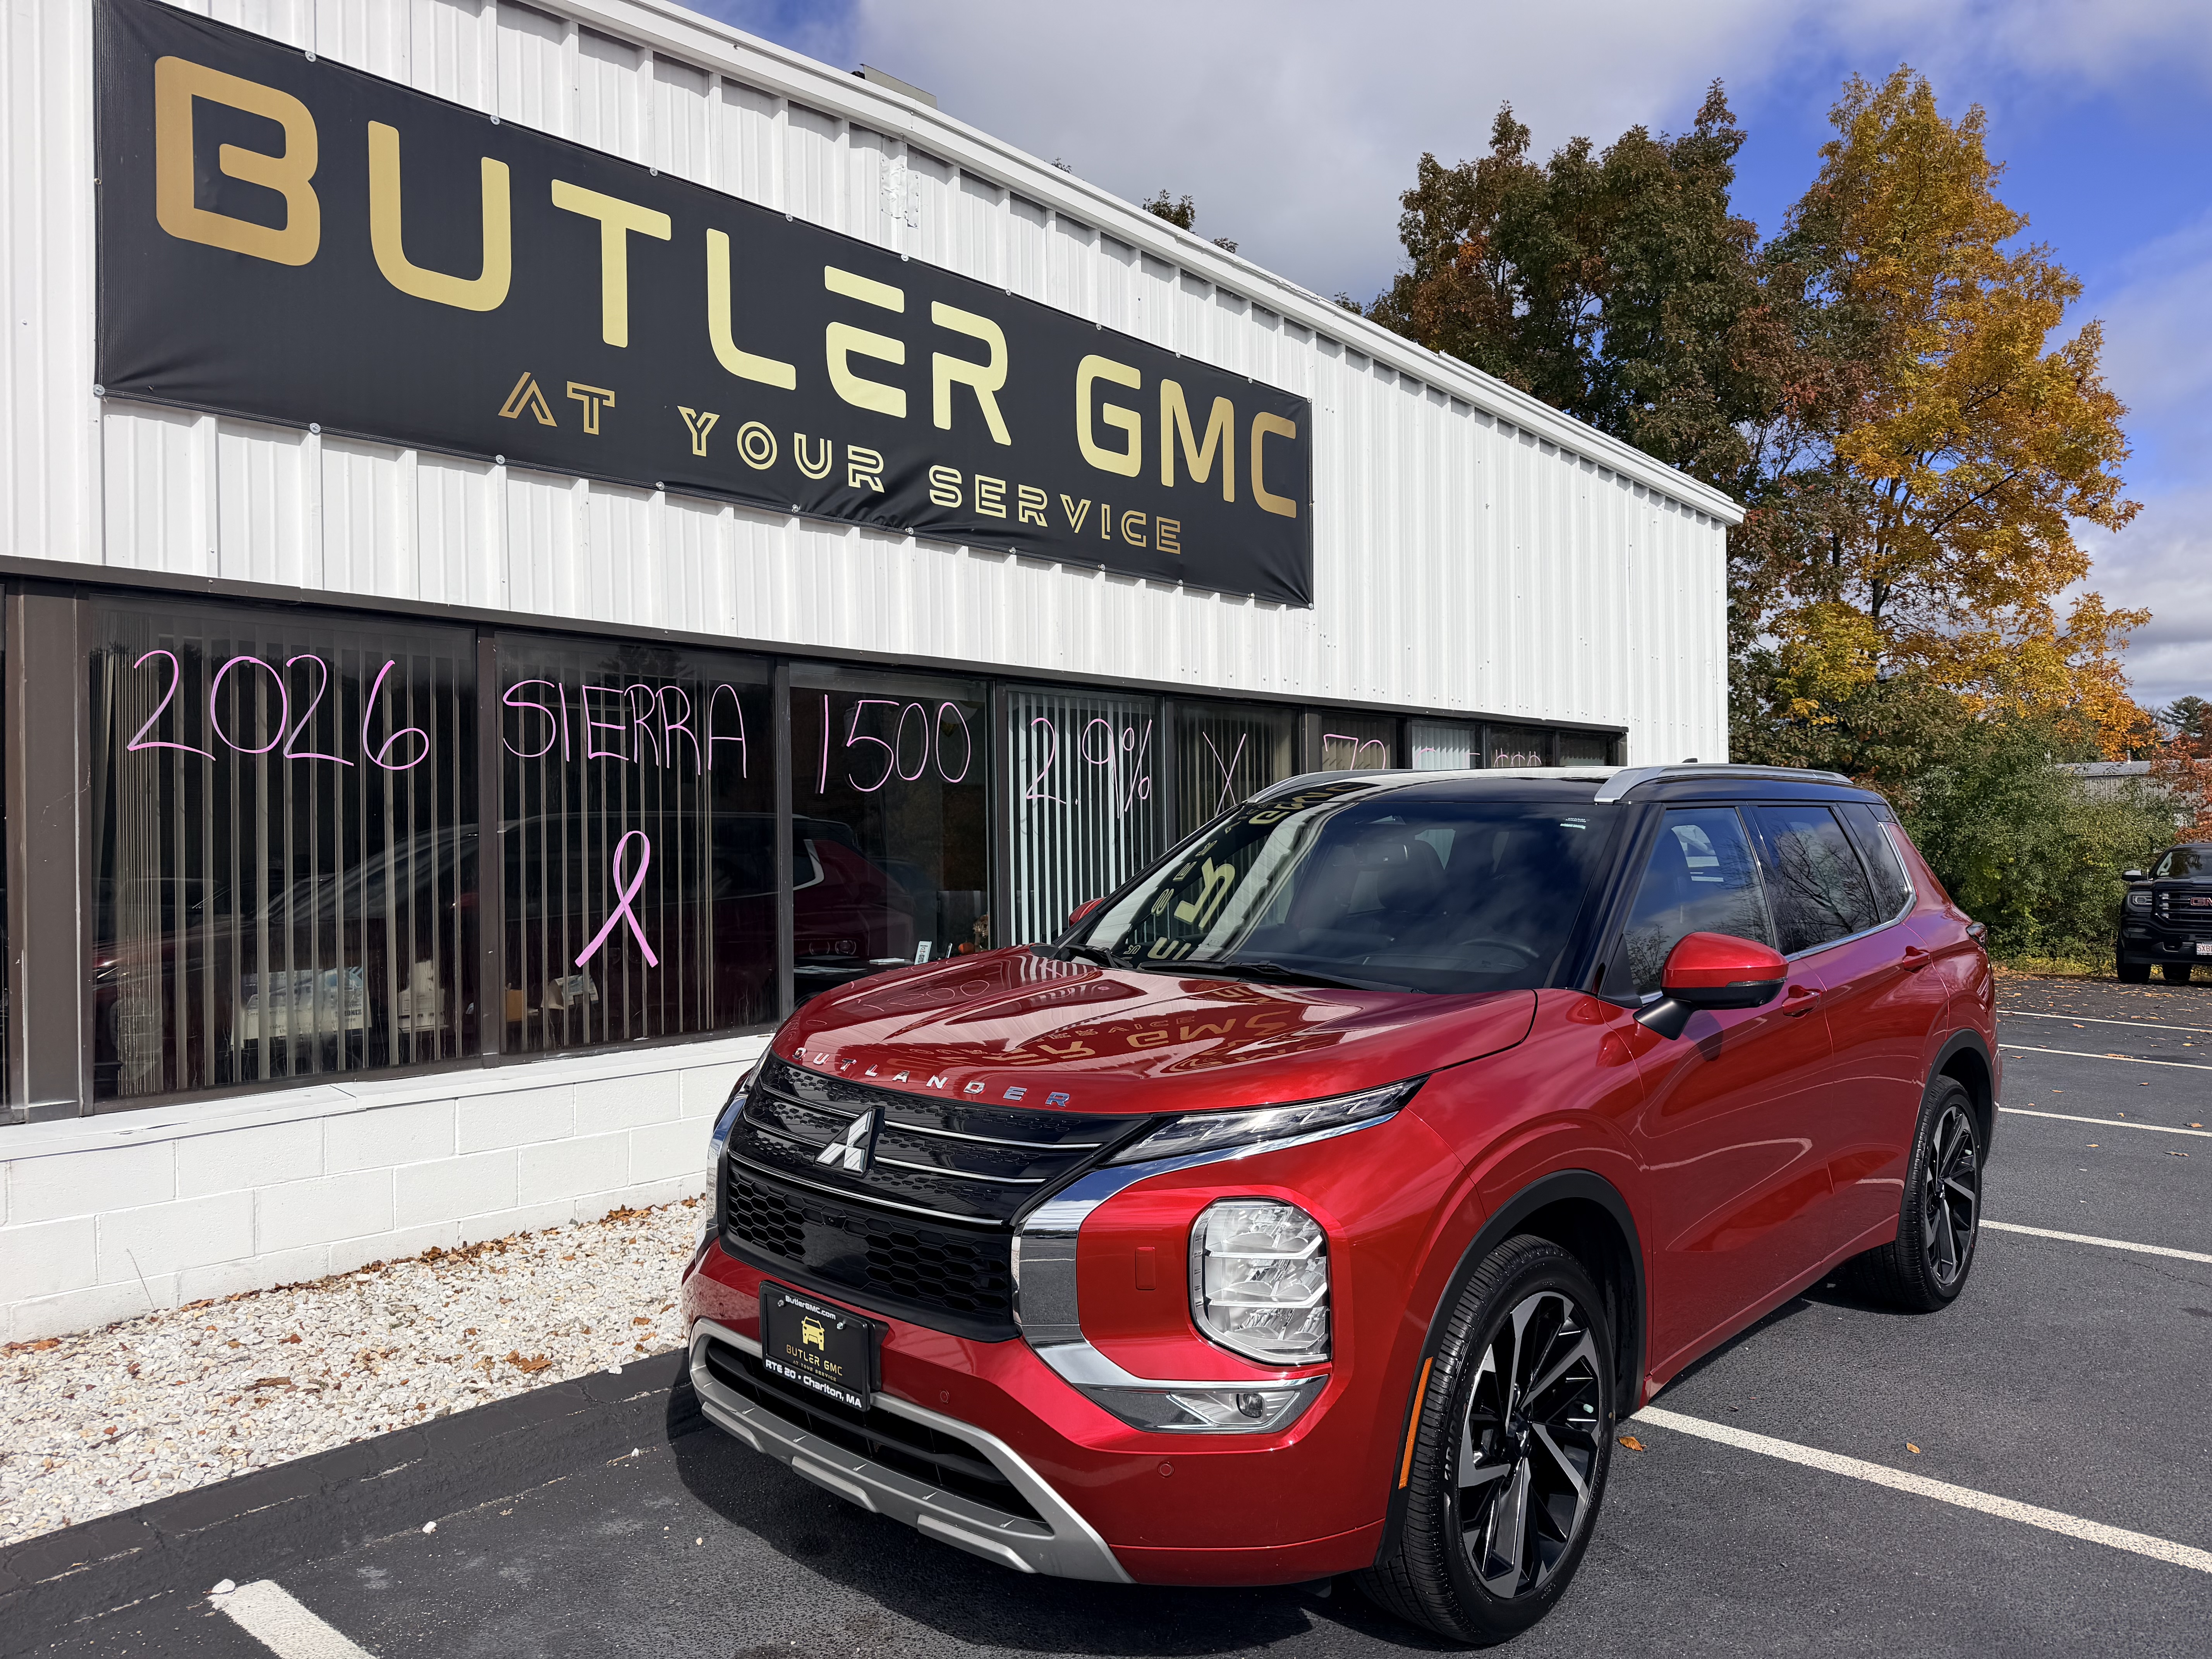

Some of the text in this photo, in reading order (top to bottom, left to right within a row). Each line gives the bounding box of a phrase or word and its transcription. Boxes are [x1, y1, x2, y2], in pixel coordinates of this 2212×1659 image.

[155, 55, 1297, 518] BUTLER GMC
[498, 372, 1181, 555] AT YOUR SERVICE
[127, 650, 429, 770] 2026
[503, 680, 747, 778] SIERRA
[819, 694, 970, 794] 1500
[1026, 717, 1152, 819] 2.9%
[792, 1048, 1070, 1107] OUTLANDER
[785, 1295, 836, 1320] ButlerGMC.com
[766, 1359, 862, 1408] RTE 20 Charlton, MA
[787, 1344, 843, 1376] BUTLER GMC
[801, 1363, 813, 1372] YOUR
[815, 1369, 836, 1381] SERVICE
